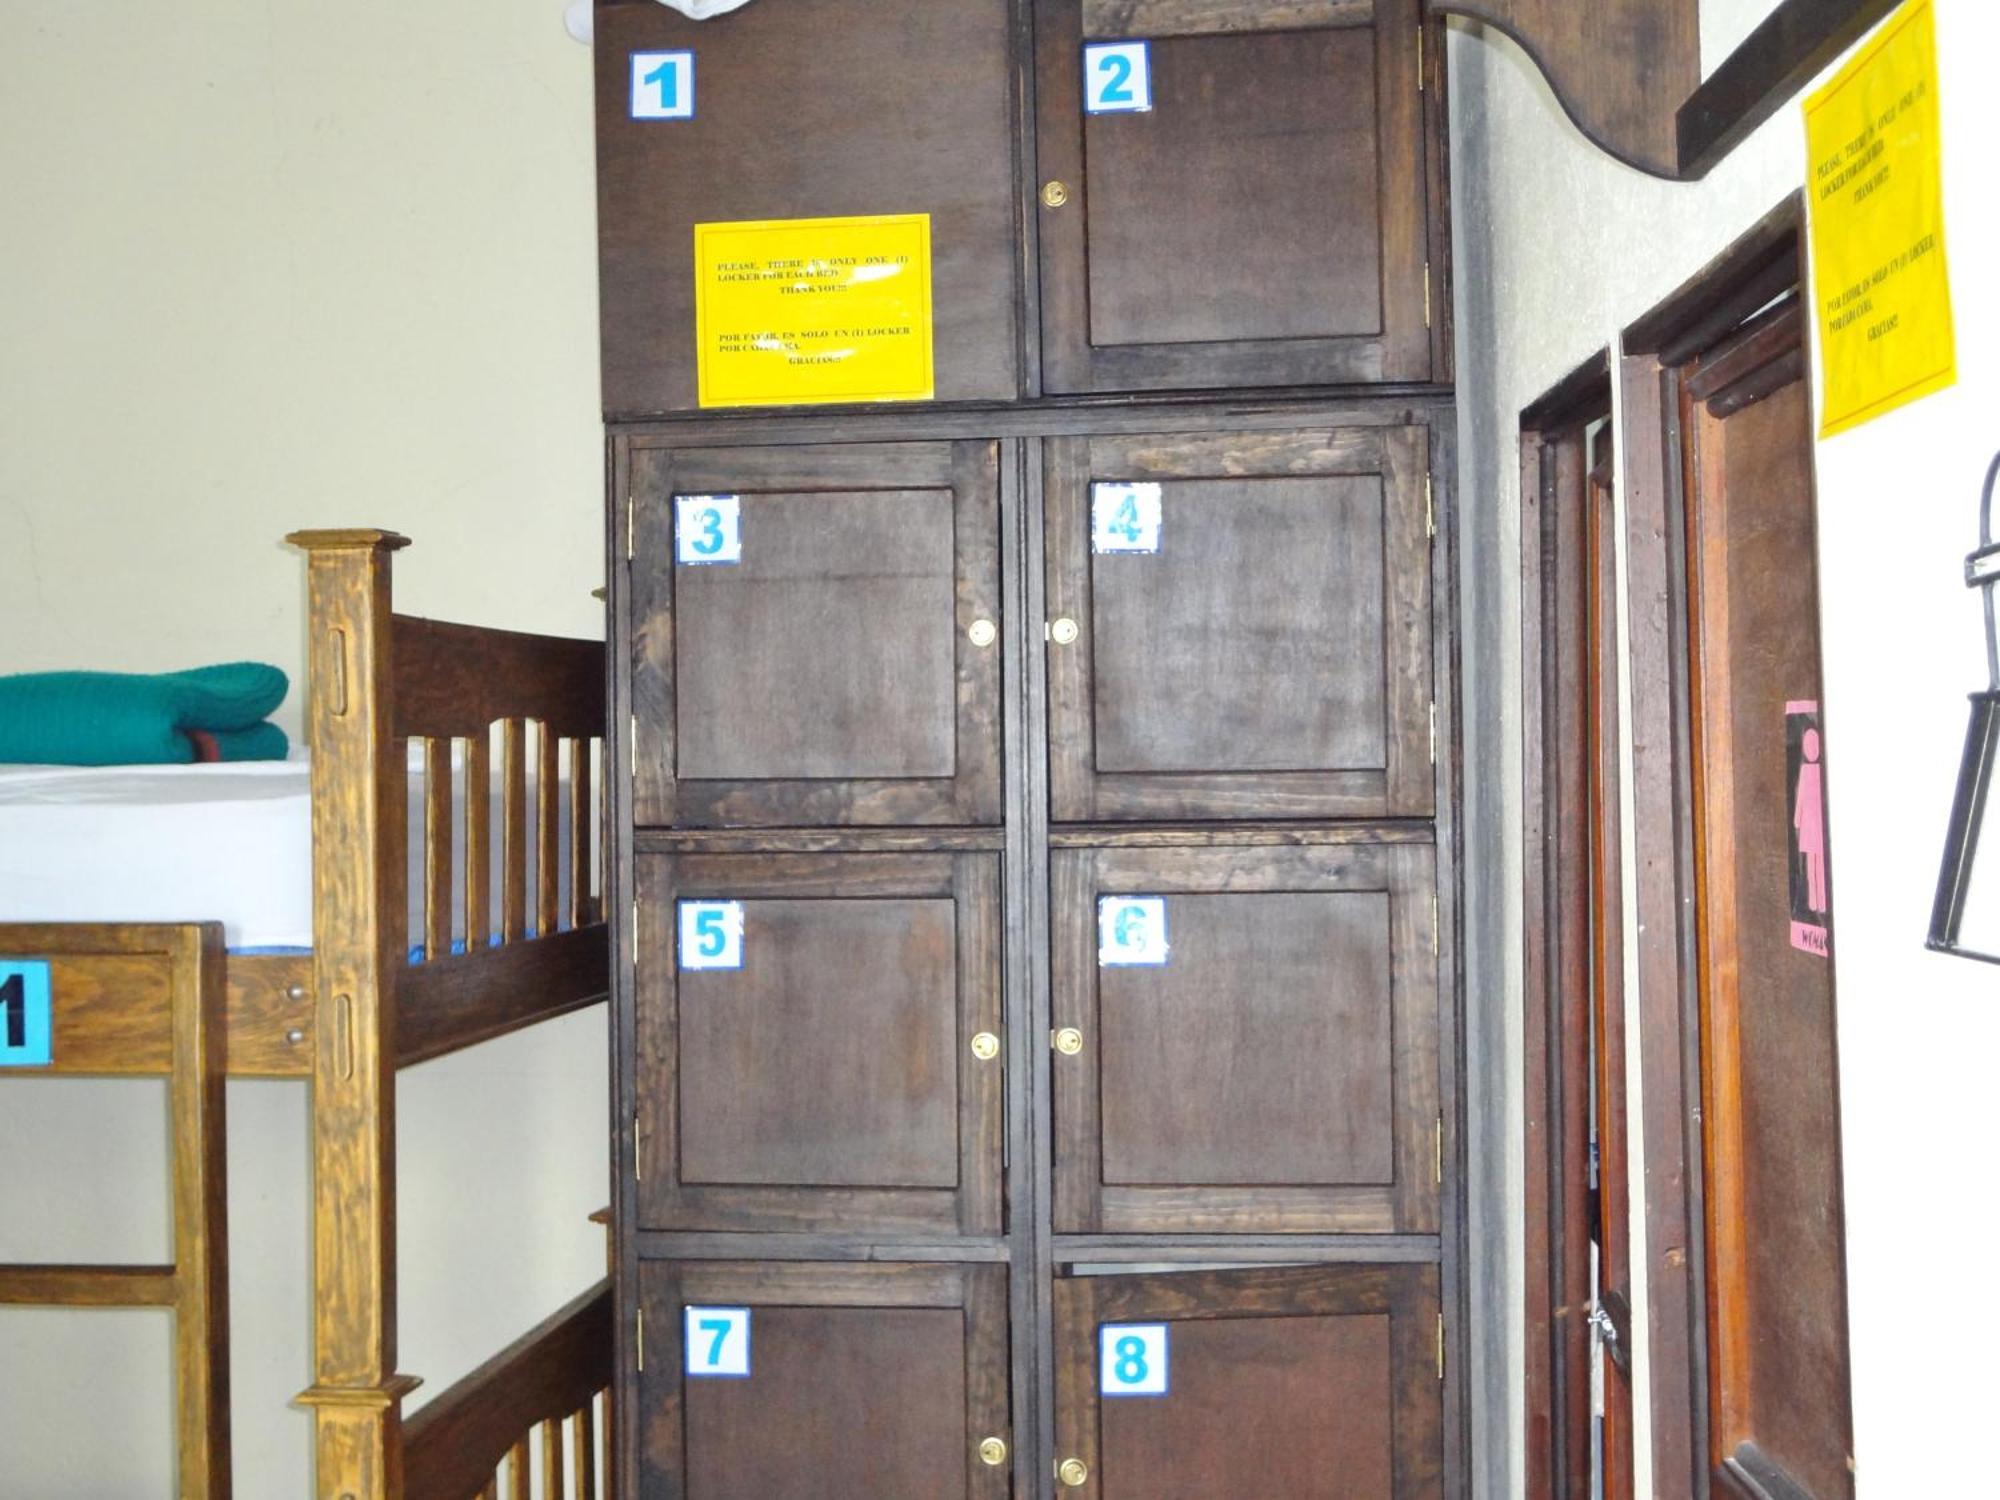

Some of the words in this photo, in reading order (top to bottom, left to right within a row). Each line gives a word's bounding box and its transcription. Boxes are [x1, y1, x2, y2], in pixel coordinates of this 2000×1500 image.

[643, 61, 676, 109] 1
[1098, 54, 1133, 103] 2
[717, 261, 760, 271] PLEASE,
[829, 257, 857, 266] ONLY
[864, 255, 889, 265] ONE
[717, 272, 760, 282] LOCKER
[779, 285, 816, 295] THANK
[719, 333, 740, 343] POR
[800, 330, 828, 338] SOLO
[834, 329, 849, 338] UN
[867, 326, 910, 337] LOCKER
[719, 344, 740, 353] POR
[691, 507, 724, 555] 3
[1107, 493, 1142, 543] 4
[696, 910, 726, 957] 5
[698, 1318, 733, 1366] 7
[1114, 1334, 1149, 1385] 8
